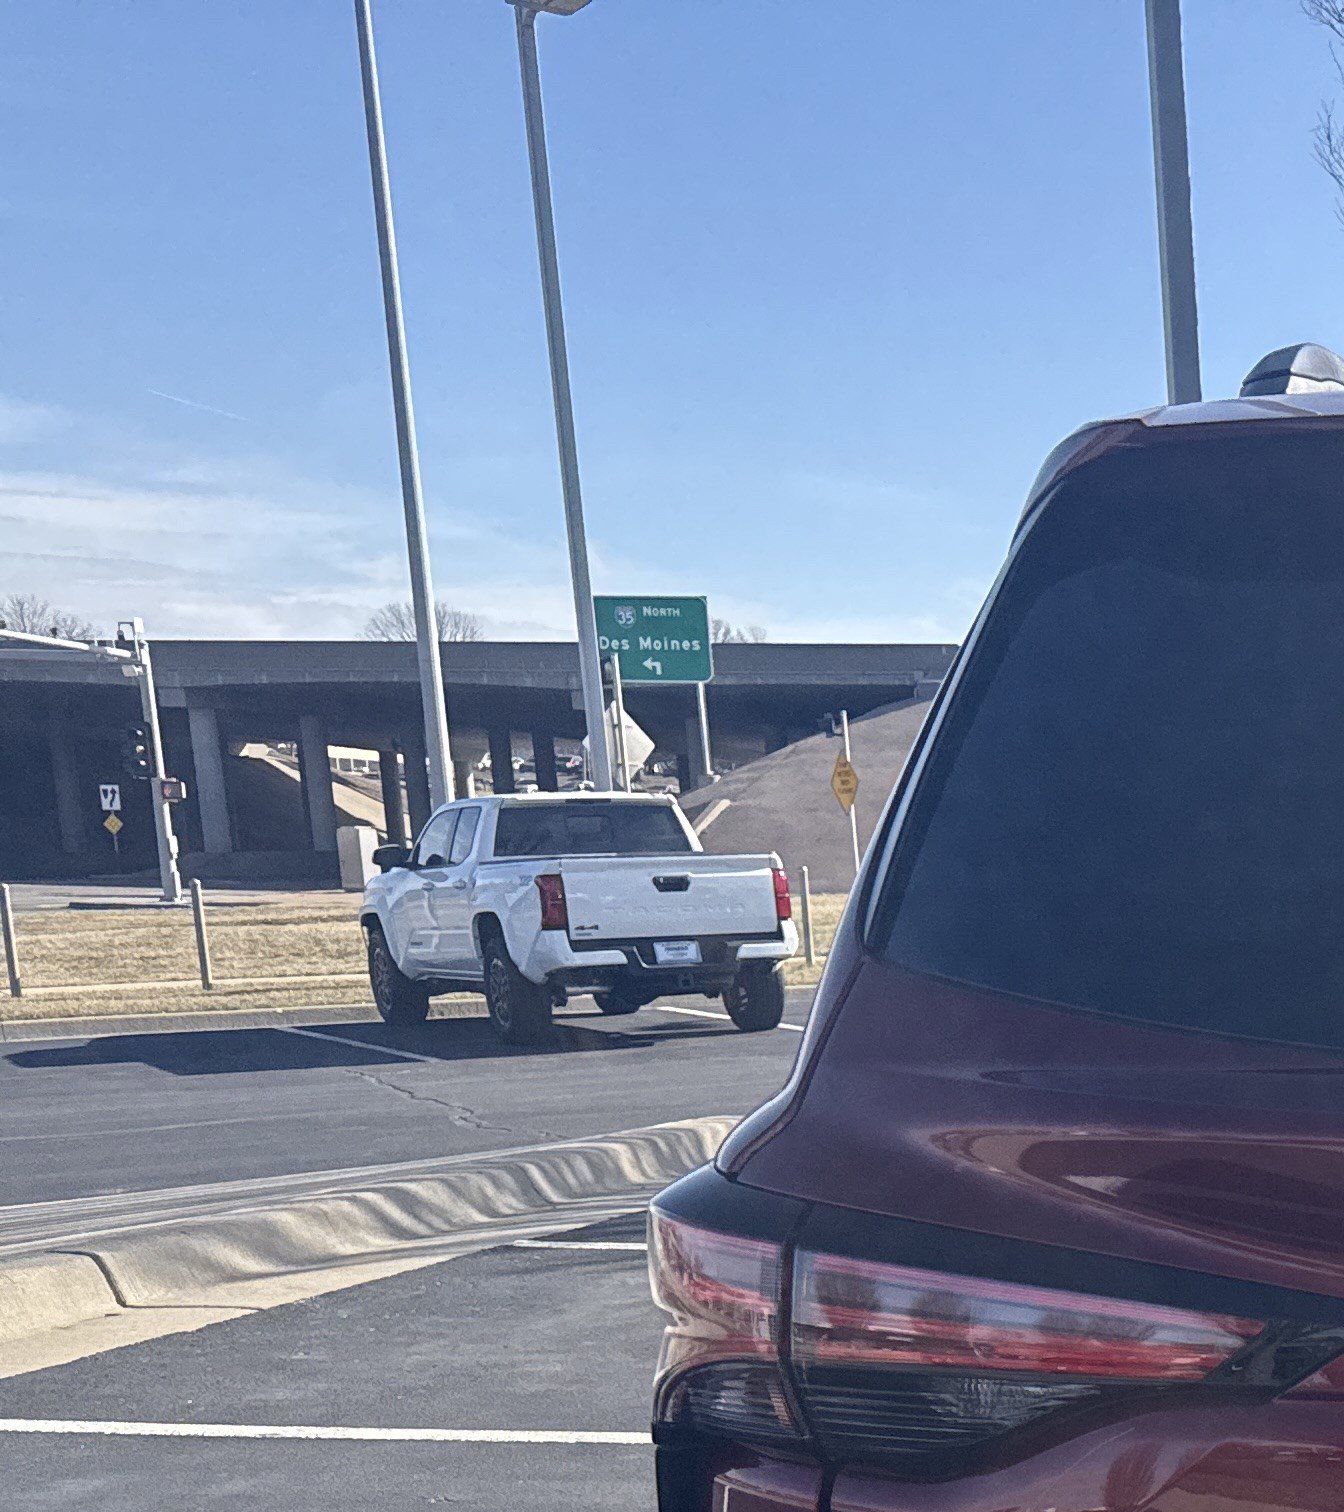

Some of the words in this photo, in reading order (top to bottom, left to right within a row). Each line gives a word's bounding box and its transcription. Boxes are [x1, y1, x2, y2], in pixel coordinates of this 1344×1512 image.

[618, 611, 634, 625] 35
[642, 606, 680, 617] NORTH
[599, 636, 630, 650] Des
[639, 636, 701, 651] Moines
